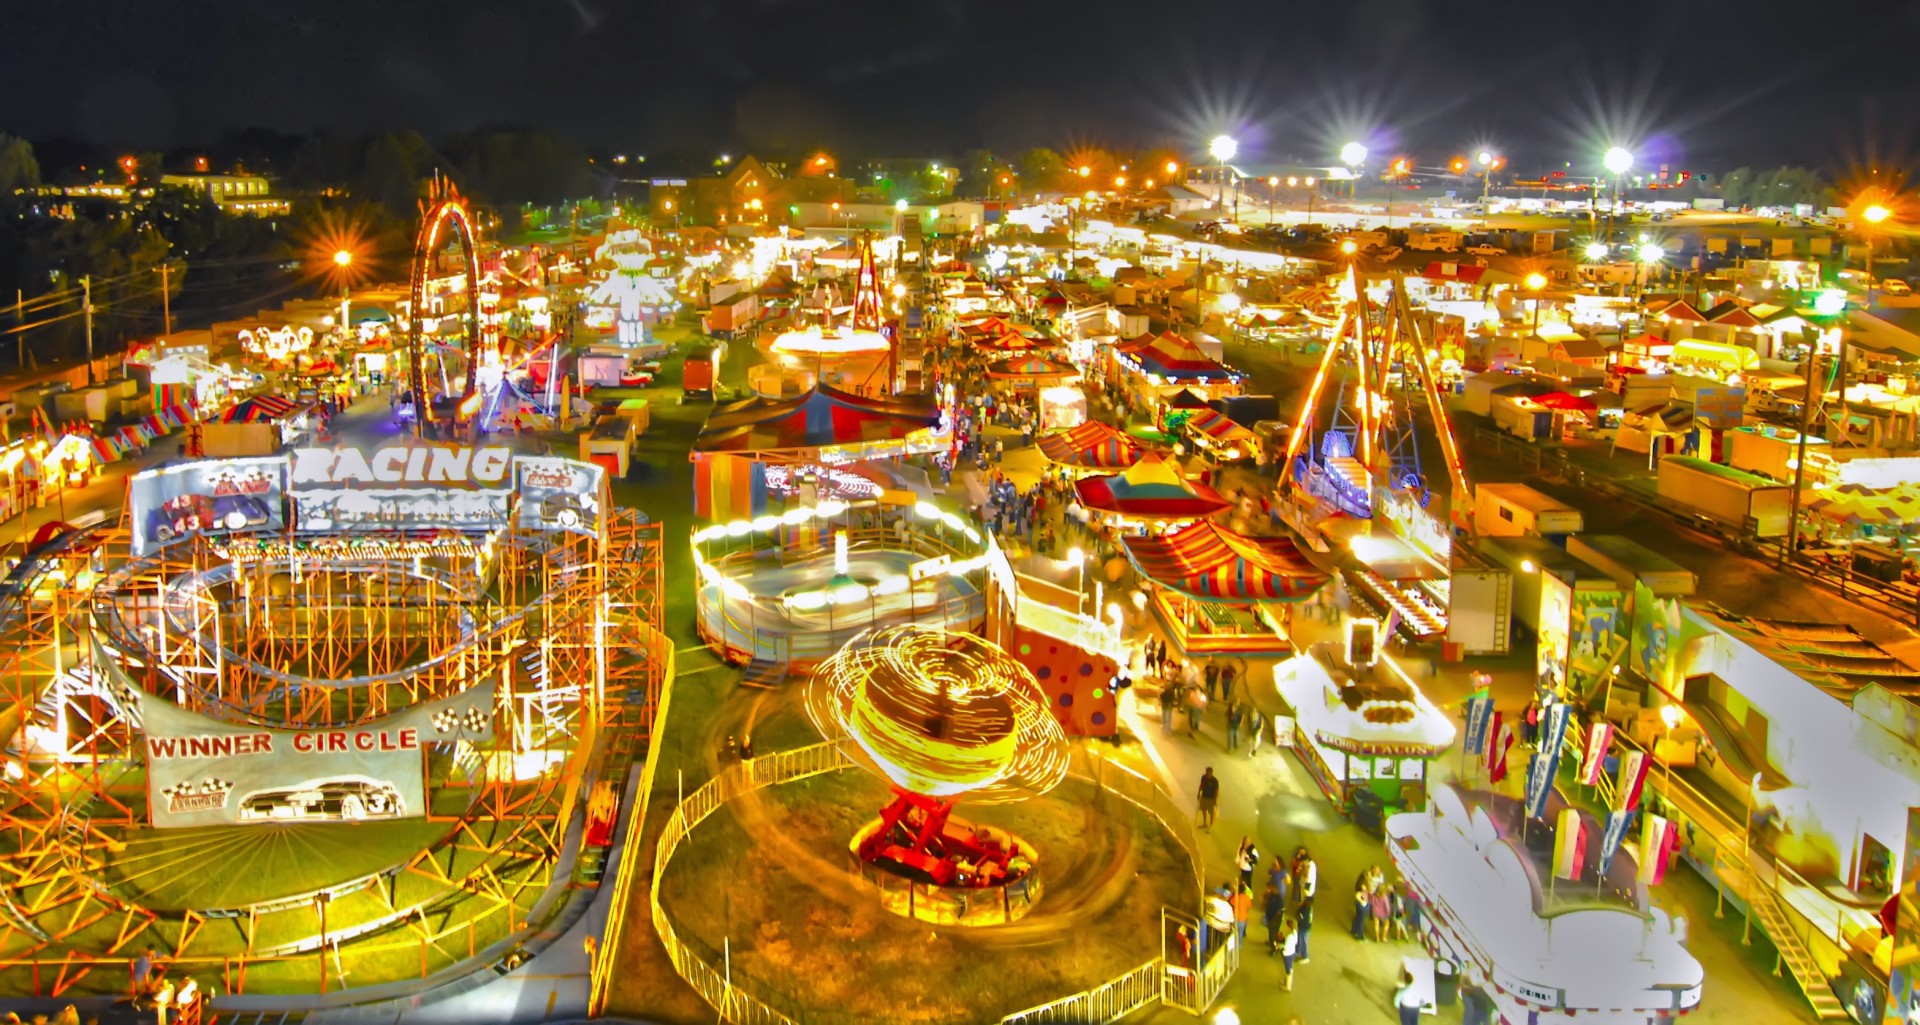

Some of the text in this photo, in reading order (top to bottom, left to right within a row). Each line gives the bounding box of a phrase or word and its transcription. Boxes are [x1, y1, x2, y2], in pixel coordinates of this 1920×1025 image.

[293, 447, 510, 482] RACING
[174, 515, 199, 533] 43
[150, 729, 418, 759] WINNER CIRCLE
[1371, 744, 1428, 755] TACOS
[368, 794, 386, 813] 3
